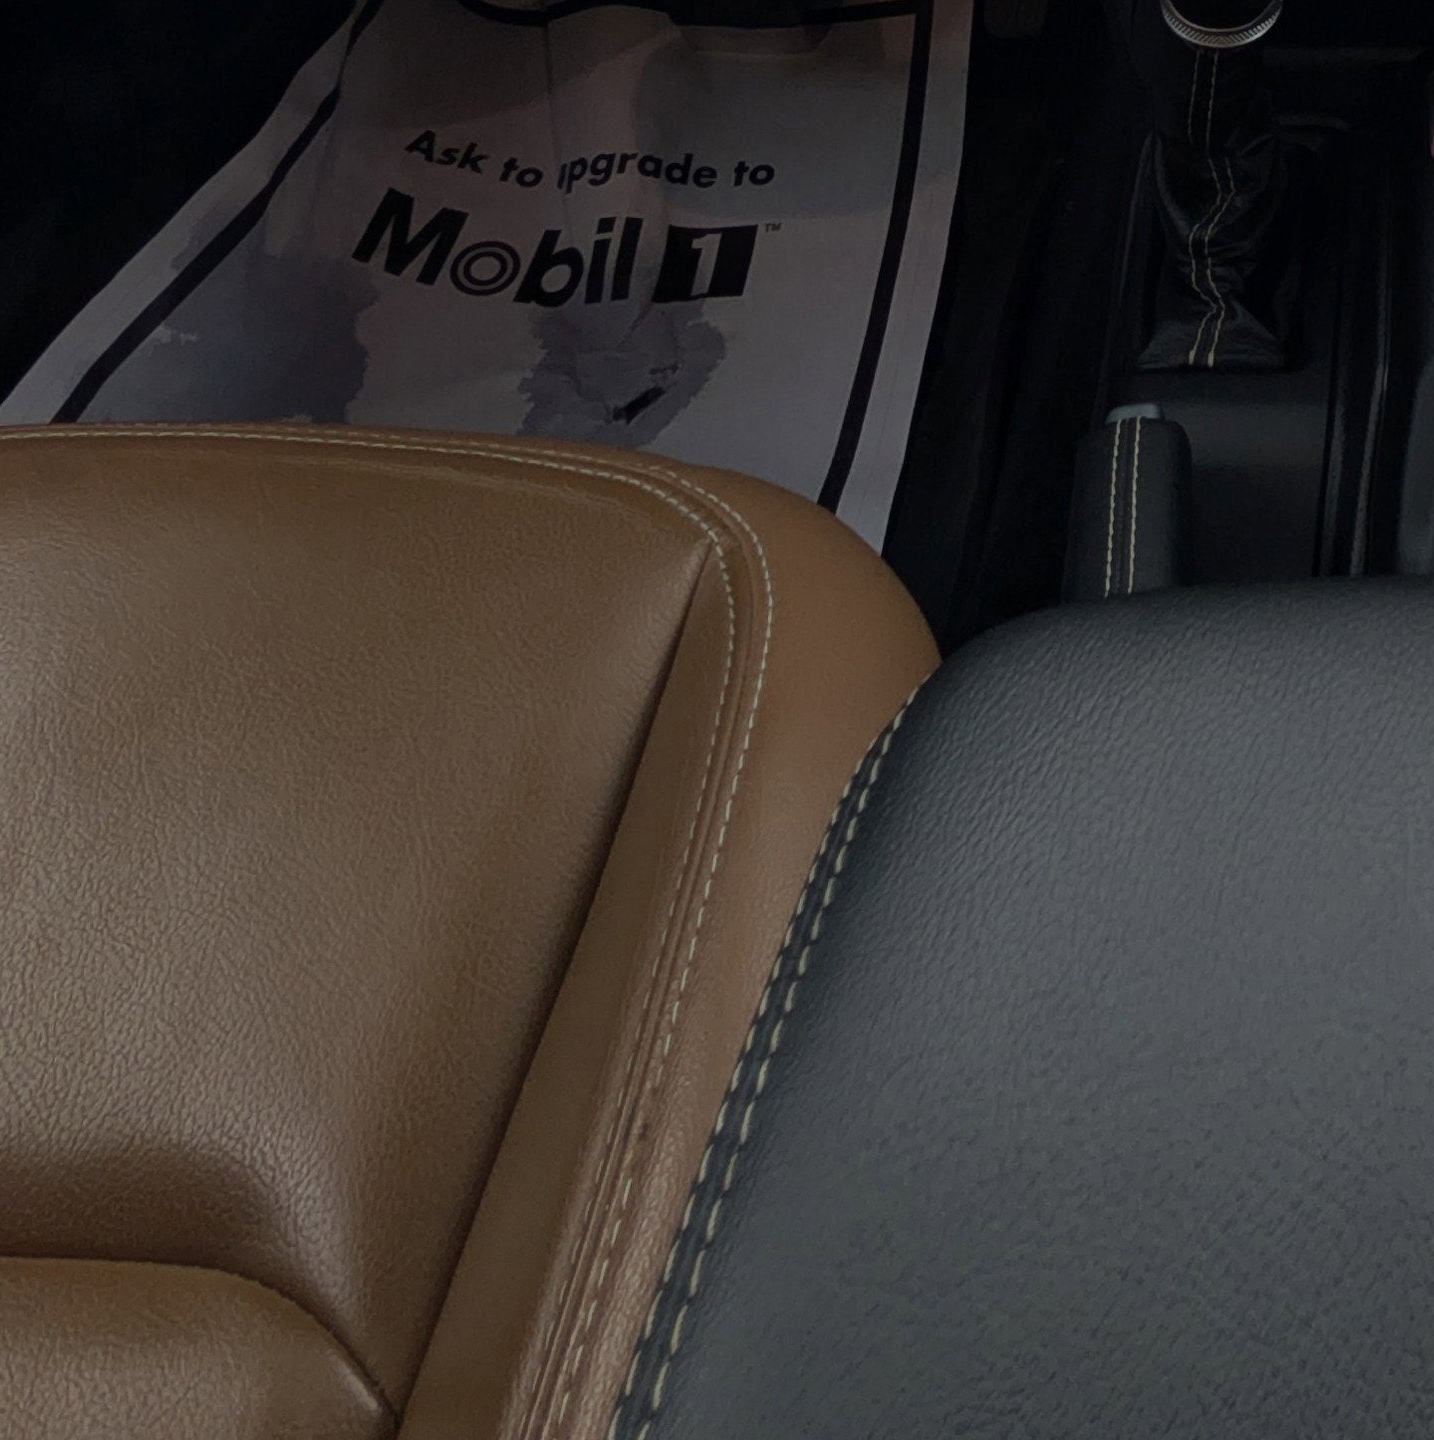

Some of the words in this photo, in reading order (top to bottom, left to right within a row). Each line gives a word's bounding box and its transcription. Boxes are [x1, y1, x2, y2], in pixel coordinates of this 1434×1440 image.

[404, 130, 490, 174] Ask
[499, 157, 544, 188] to
[556, 152, 718, 194] pgrade
[734, 160, 775, 187] to
[351, 186, 644, 308] Mobil
